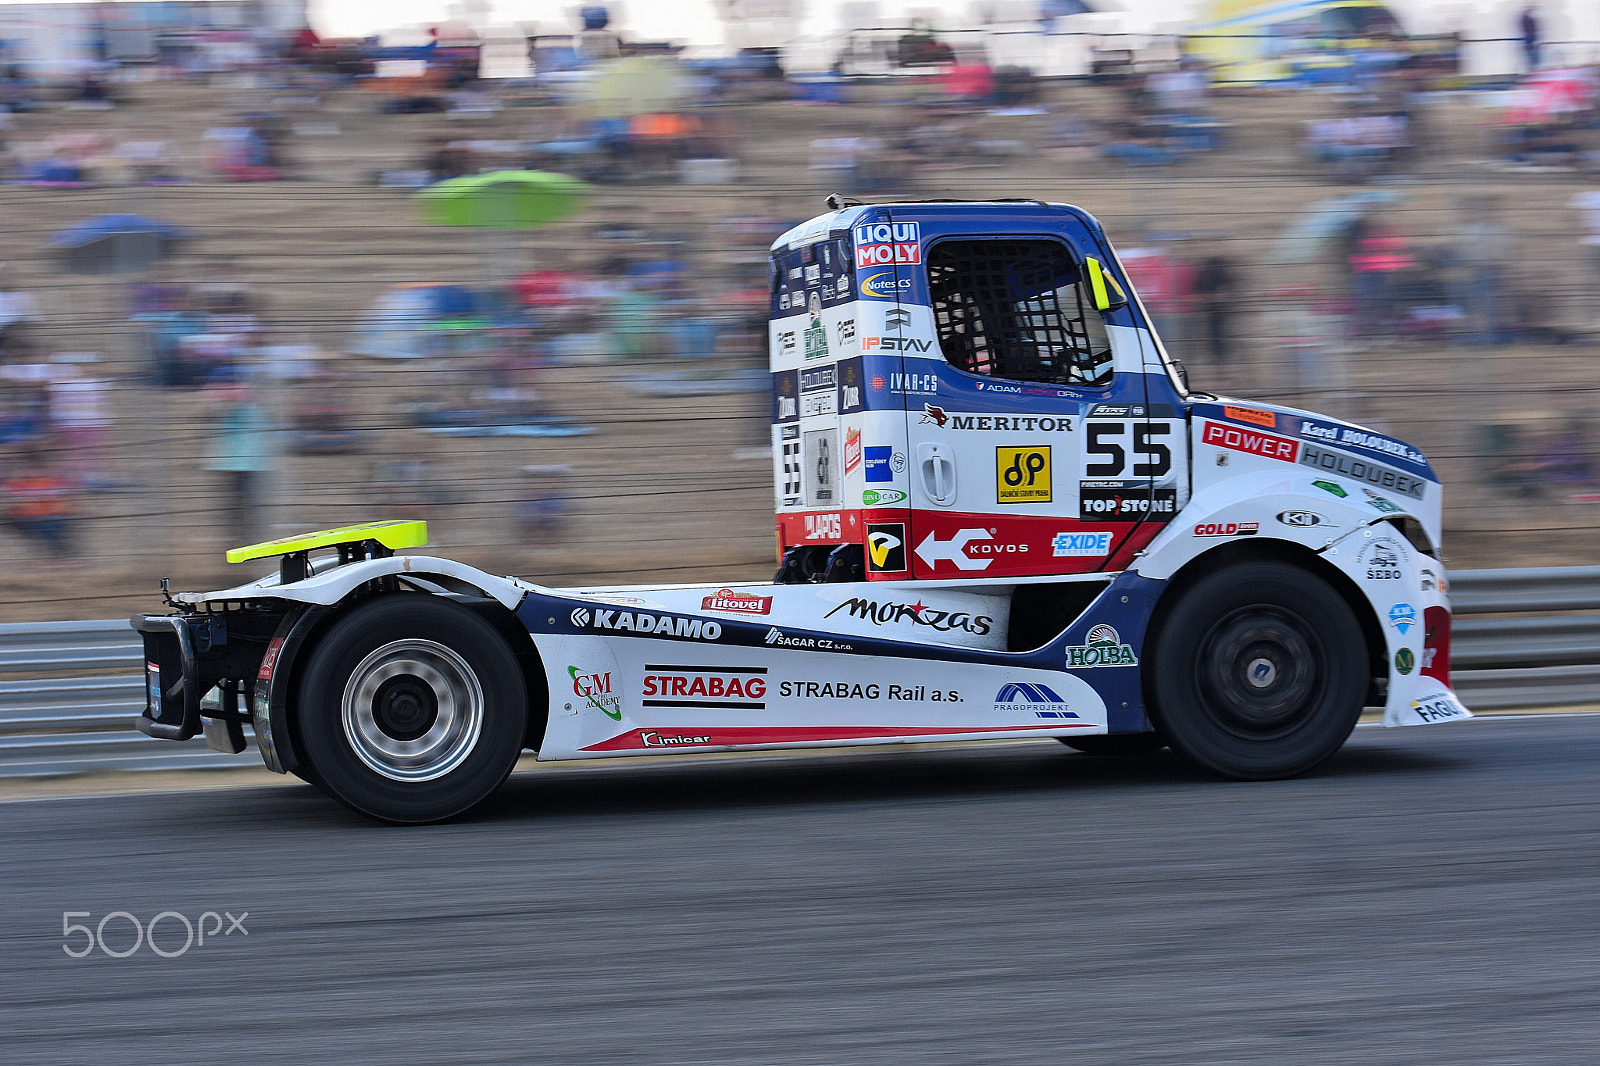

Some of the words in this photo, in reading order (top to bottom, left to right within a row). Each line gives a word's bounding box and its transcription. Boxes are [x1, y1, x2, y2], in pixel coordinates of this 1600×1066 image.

[856, 223, 917, 243] LIQUI
[857, 244, 919, 266] MOLY
[866, 280, 896, 291] Notes
[898, 279, 912, 288] CS
[862, 337, 933, 352] IPSTAV
[951, 415, 1073, 432] MERITOR
[1208, 426, 1292, 459] POWER
[1300, 421, 1339, 439] Karel
[1341, 429, 1409, 457] HOLOUBEK
[1086, 422, 1171, 477] 55
[1303, 448, 1425, 496] HOLOUBEK
[1194, 523, 1237, 536] GOLD
[970, 543, 1029, 554] KOVOS
[1055, 534, 1109, 550] EXIDE
[711, 597, 764, 611] Litovel
[593, 608, 723, 641] KADAMO
[777, 636, 815, 648] SAGAR
[817, 639, 833, 649] CZ
[1068, 646, 1136, 667] HOLBA
[573, 672, 613, 698] GM
[642, 675, 767, 699] STRABAG
[779, 681, 880, 699] STRABAG
[888, 684, 925, 702] Rail
[931, 689, 964, 703] a.s.
[993, 703, 1070, 712] PRAGOPROJEKT
[640, 731, 712, 748] Kimicar
